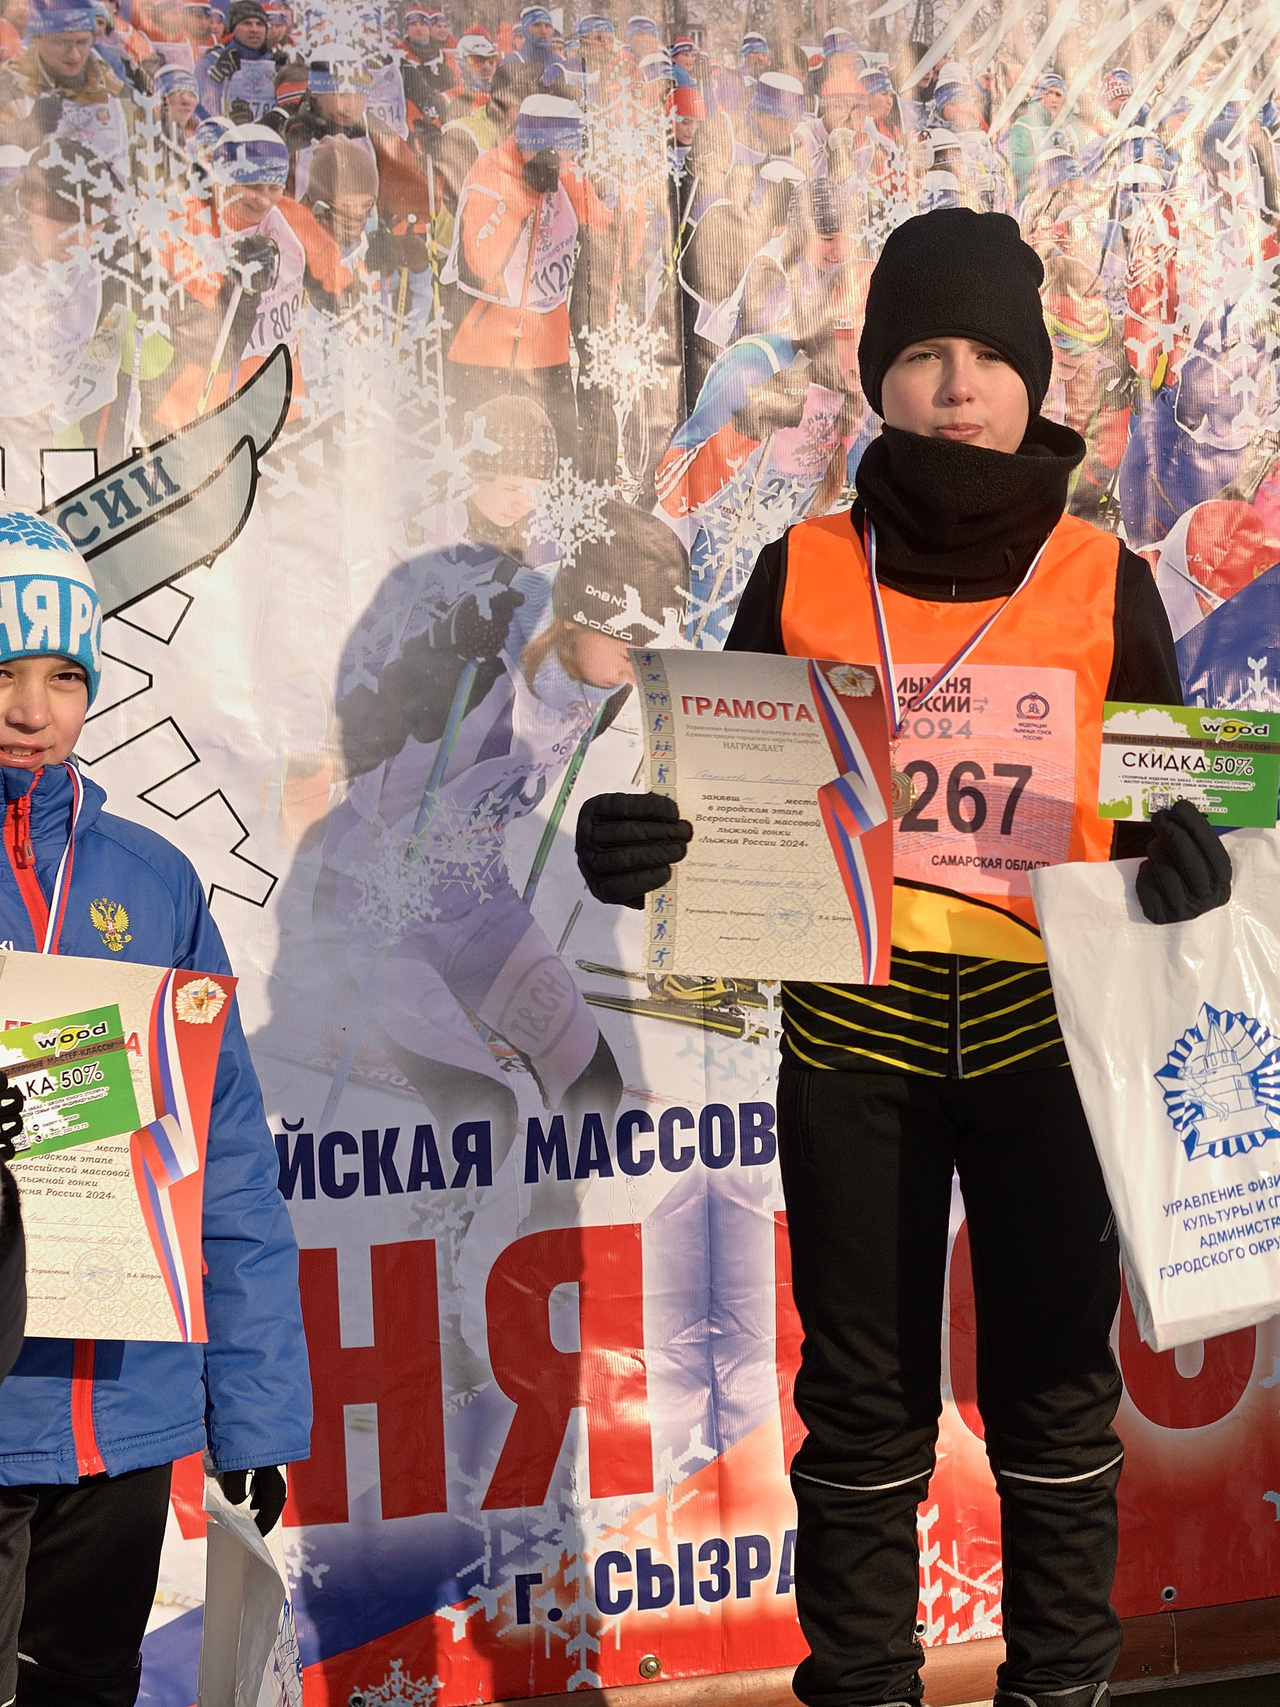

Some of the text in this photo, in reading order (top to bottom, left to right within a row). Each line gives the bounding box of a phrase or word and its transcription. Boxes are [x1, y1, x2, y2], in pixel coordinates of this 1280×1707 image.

[681, 695, 816, 723] ГРАМОТА
[900, 717, 973, 740] 2024
[1202, 722, 1269, 737] wood
[723, 742, 785, 753] НАГРАЖДАЕТ
[1122, 752, 1254, 774] СКИДКА 50%
[784, 798, 818, 806] место
[899, 759, 1033, 836] 267
[716, 805, 768, 816] городском
[695, 814, 822, 828] Всероссийской массовой
[717, 827, 759, 836] лыжной
[742, 837, 777, 847] России
[931, 855, 1051, 872] САМАРСКАЯ ОБЛАСТ
[37, 1022, 108, 1050] wood
[20, 1062, 103, 1100] КА 50%
[94, 1144, 129, 1154] место
[275, 1101, 777, 1201] ЙСКАЯ МАССОВ
[30, 1152, 113, 1165] одском этапе
[6, 1163, 130, 1178] ероссийской массовой
[19, 1175, 98, 1187] лыжной гонки
[45, 1188, 82, 1199] России
[1183, 1203, 1253, 1232] КУЛЬТУРЫ
[1256, 1199, 1265, 1213] И
[1159, 1246, 1245, 1280] ГОРОДСКОГО
[165, 1223, 654, 1541] НЯ
